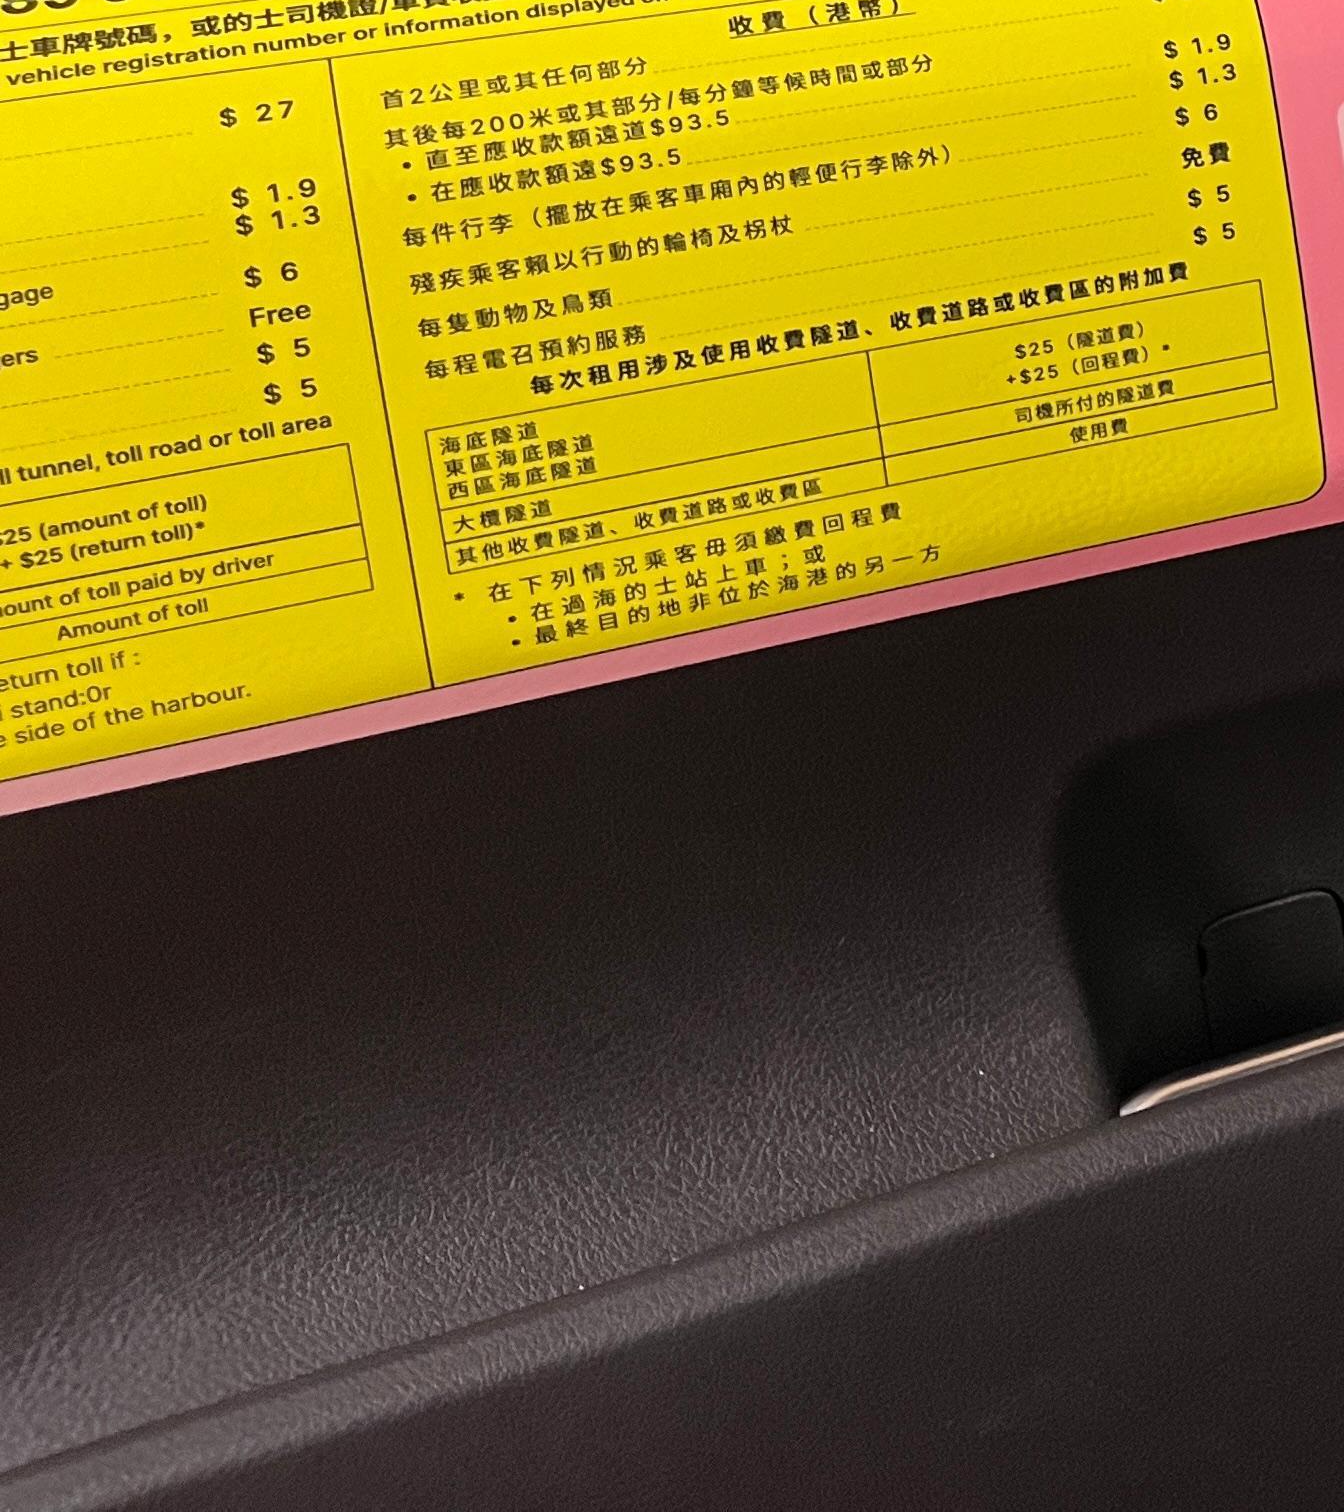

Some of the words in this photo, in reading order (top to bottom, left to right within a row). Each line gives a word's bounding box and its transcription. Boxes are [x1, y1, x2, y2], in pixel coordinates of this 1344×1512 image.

[6, 62, 96, 86] vehicle
[103, 44, 247, 75] registration
[253, 29, 346, 55] number
[353, 25, 378, 42] or
[385, 6, 519, 37] information
[1191, 33, 1232, 56] 1.9
[379, 56, 648, 110] 首2公里或其任何部分
[1197, 63, 1237, 86] 1.3
[256, 100, 294, 123] 27
[1204, 103, 1219, 122] 6
[1180, 141, 1231, 170] 免費
[267, 177, 317, 204] 1.9
[1217, 184, 1231, 203] 5
[271, 205, 321, 230] 1.3
[1221, 221, 1236, 241] 5
[281, 261, 299, 282] 6
[249, 303, 312, 328] Free
[417, 288, 614, 338] 每隻動物及鳥類
[294, 337, 311, 358] 5
[424, 324, 647, 380] 每程電召預約服務
[300, 377, 318, 398] 5
[1014, 379, 1175, 424] 司機所付的隧道費
[439, 421, 538, 456] 海底隧道
[1070, 418, 1129, 444] 使用費
[17, 454, 100, 482] tunnel,
[106, 444, 143, 468] toll
[149, 435, 201, 460] road
[209, 431, 233, 449] or
[238, 421, 275, 444] toll
[282, 413, 333, 437] area
[444, 434, 595, 478] 東區海底隧道
[447, 457, 598, 500] 西區海底隧道
[0, 525, 32, 547] 25
[39, 509, 132, 541] (amount
[139, 502, 160, 522] of
[164, 493, 208, 517] toll)
[20, 546, 63, 569] $25
[70, 533, 146, 561] (return
[0, 594, 53, 617] ount
[59, 587, 81, 606] of
[87, 581, 121, 600] toll
[128, 571, 173, 598] paid
[180, 565, 206, 586] by
[212, 551, 274, 576] driver
[57, 614, 142, 641] Amount
[148, 603, 169, 623] of
[175, 598, 209, 617] toll
[66, 655, 104, 678] toll
[110, 650, 125, 670] if
[15, 722, 65, 744] side
[73, 711, 96, 732] of
[104, 705, 145, 726] the
[151, 683, 252, 716] harbour.
